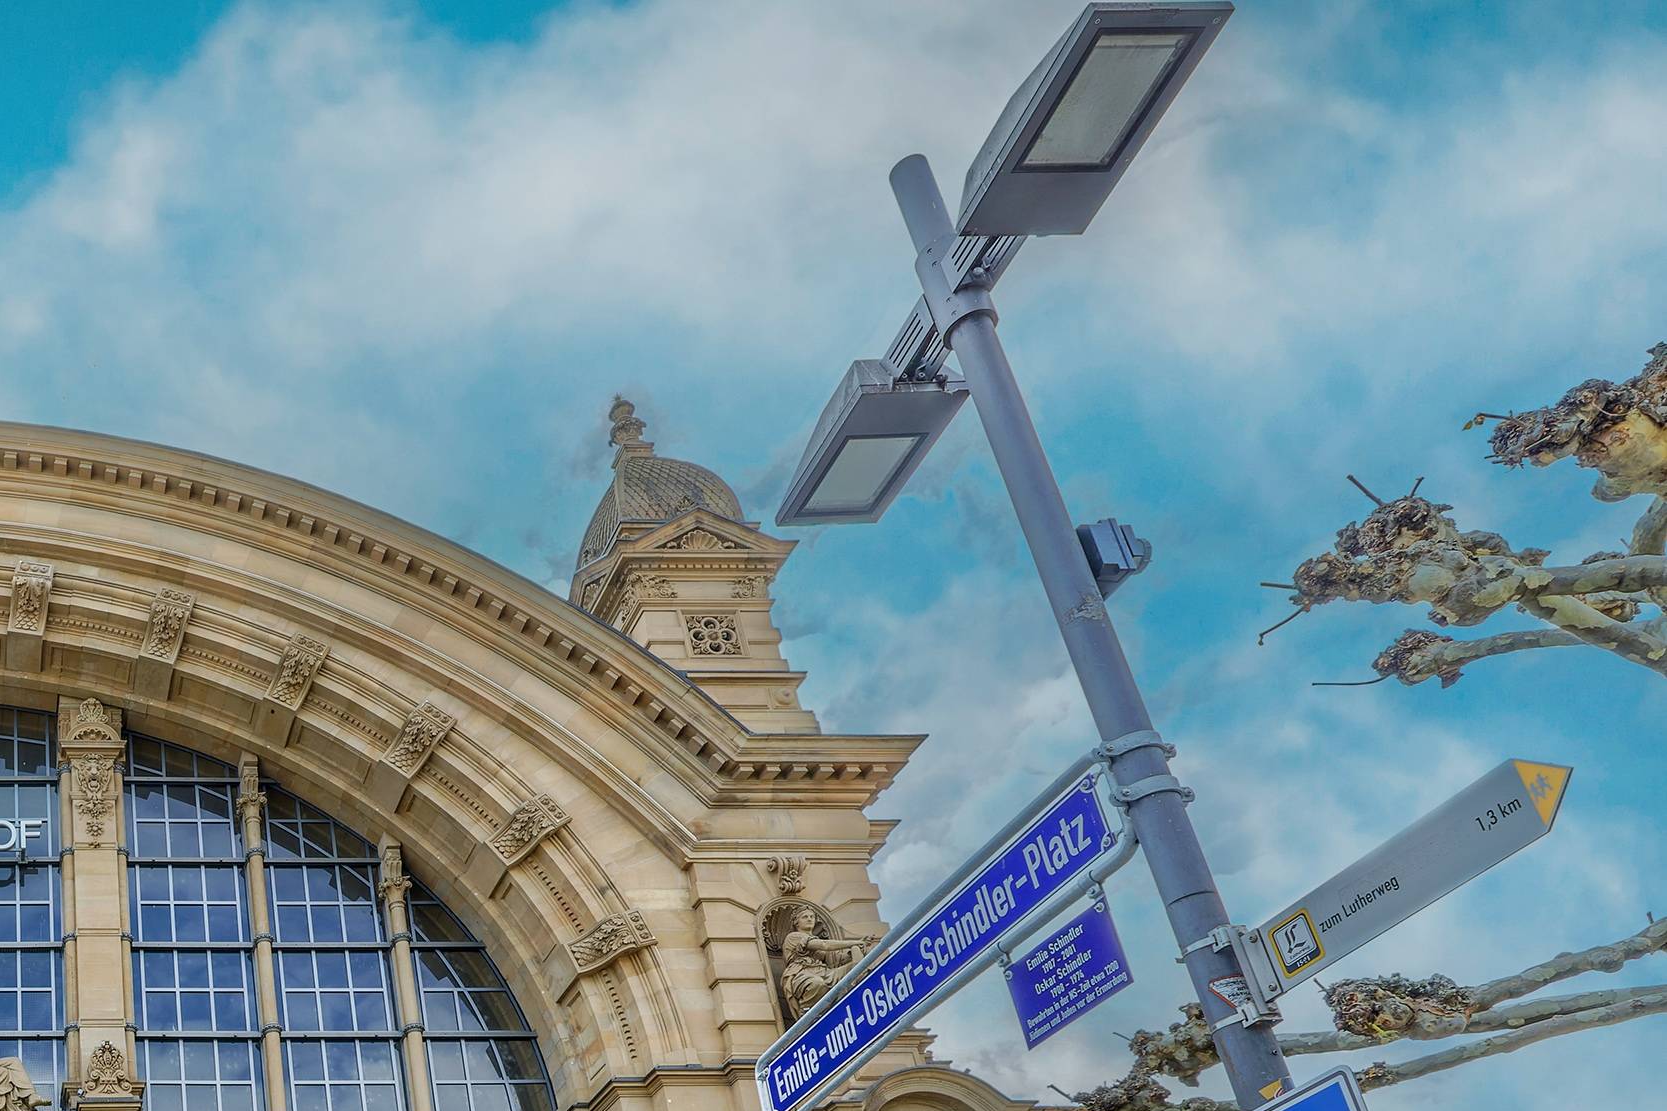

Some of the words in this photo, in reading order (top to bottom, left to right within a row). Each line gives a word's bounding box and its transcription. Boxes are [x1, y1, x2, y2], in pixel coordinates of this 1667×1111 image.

[1475, 809, 1498, 832] 1,3
[1497, 798, 1522, 818] km
[1319, 912, 1343, 933] zum
[1342, 876, 1400, 918] Lutherweg
[773, 813, 1092, 1103] Emilie-und-Oskar-Schindler-Platz
[1026, 950, 1049, 972] Emilie
[1048, 923, 1085, 955] Schindler
[1042, 959, 1056, 974] 1907
[1061, 943, 1077, 961] 2001
[1034, 974, 1057, 995] Oskar
[1056, 949, 1093, 981] Schindler
[1060, 995, 1070, 1007] der
[1069, 978, 1091, 1001] NS-Zeit
[1091, 972, 1105, 986] etwa
[1105, 960, 1120, 976] 1200
[1050, 1015, 1061, 1027] und
[1076, 998, 1086, 1009] vor
[1085, 992, 1096, 1003] der
[1095, 971, 1128, 997] Ermordung
